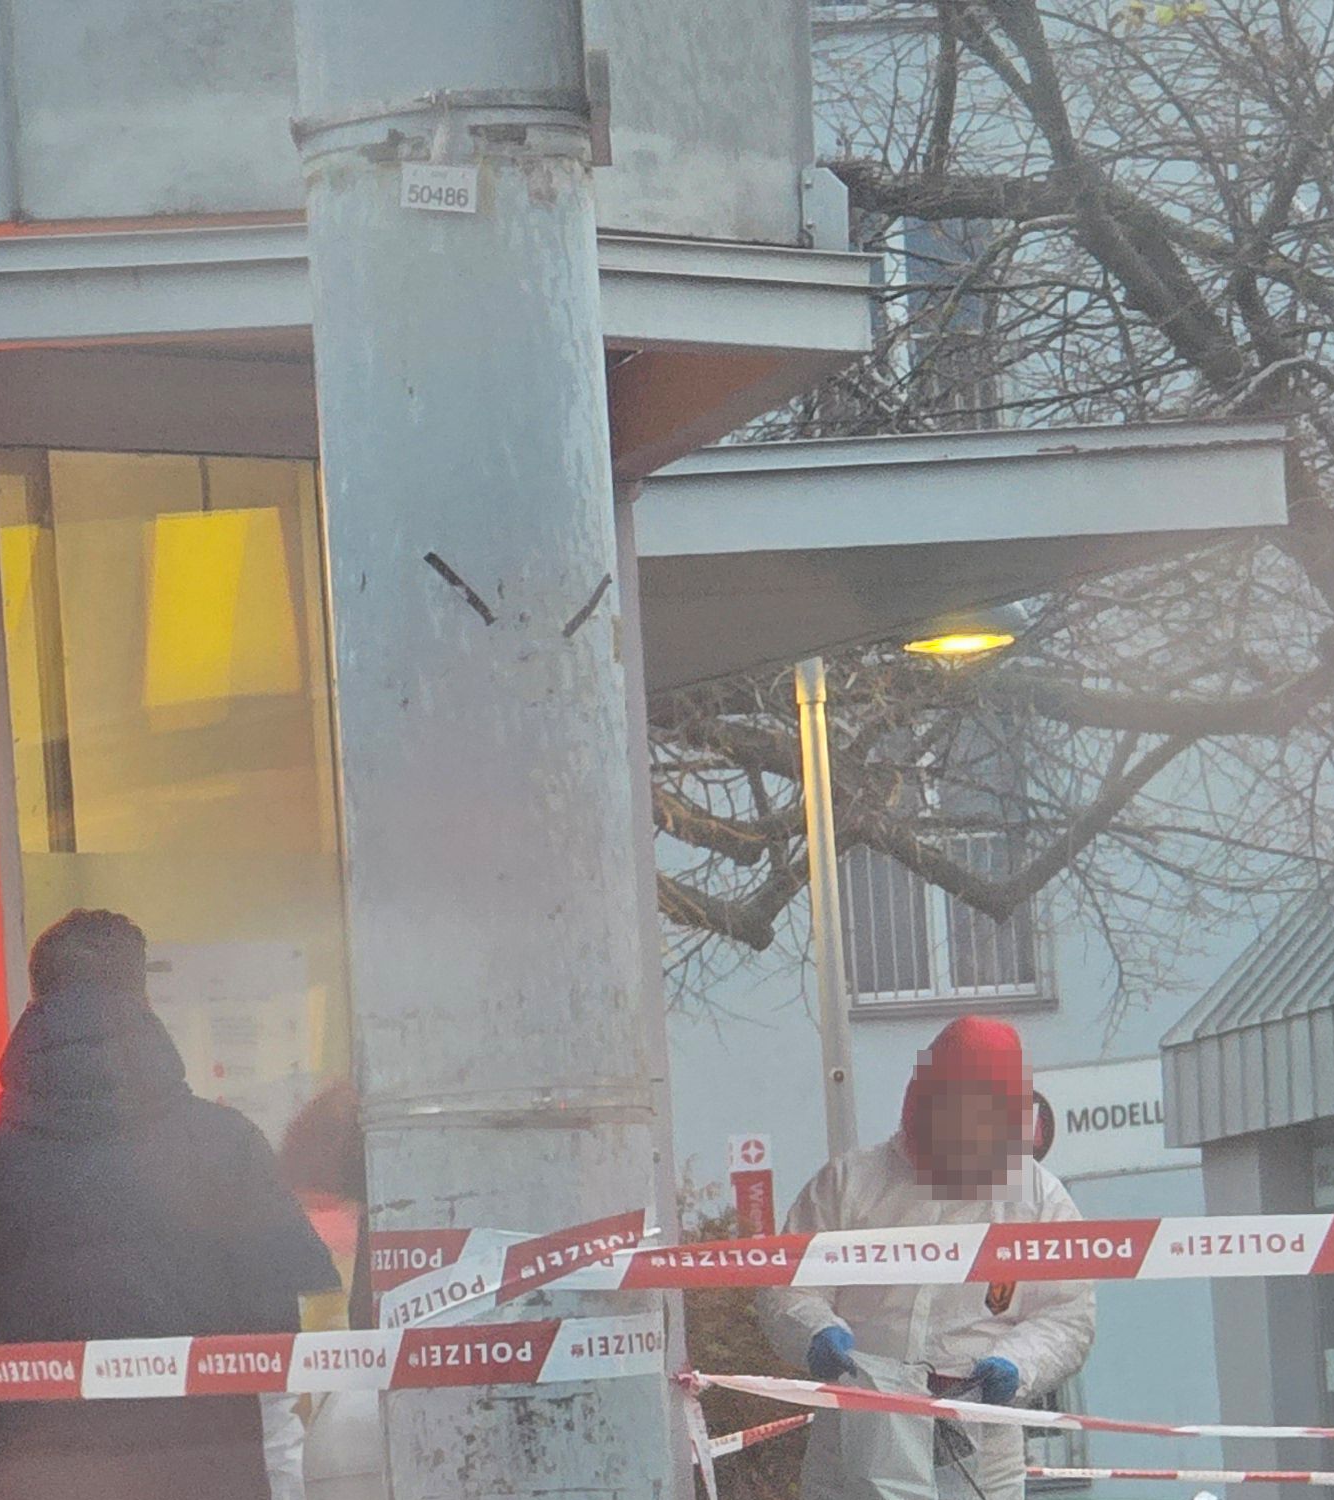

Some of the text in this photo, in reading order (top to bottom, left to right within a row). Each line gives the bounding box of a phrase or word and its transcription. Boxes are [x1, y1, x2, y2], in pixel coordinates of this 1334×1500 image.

[408, 184, 469, 207] 50486
[842, 1243, 960, 1264] POLIZEI
[1016, 1237, 1132, 1260] POLIZEI
[1189, 1233, 1305, 1256] POLIZEI
[394, 1274, 486, 1327] POLIZEI
[207, 1351, 282, 1375] POLIZEI
[313, 1347, 387, 1369] POLIZEI
[421, 1340, 533, 1365] POLIZEI
[2, 1360, 75, 1383] POLIZEI
[105, 1356, 178, 1378] POLIZEI
